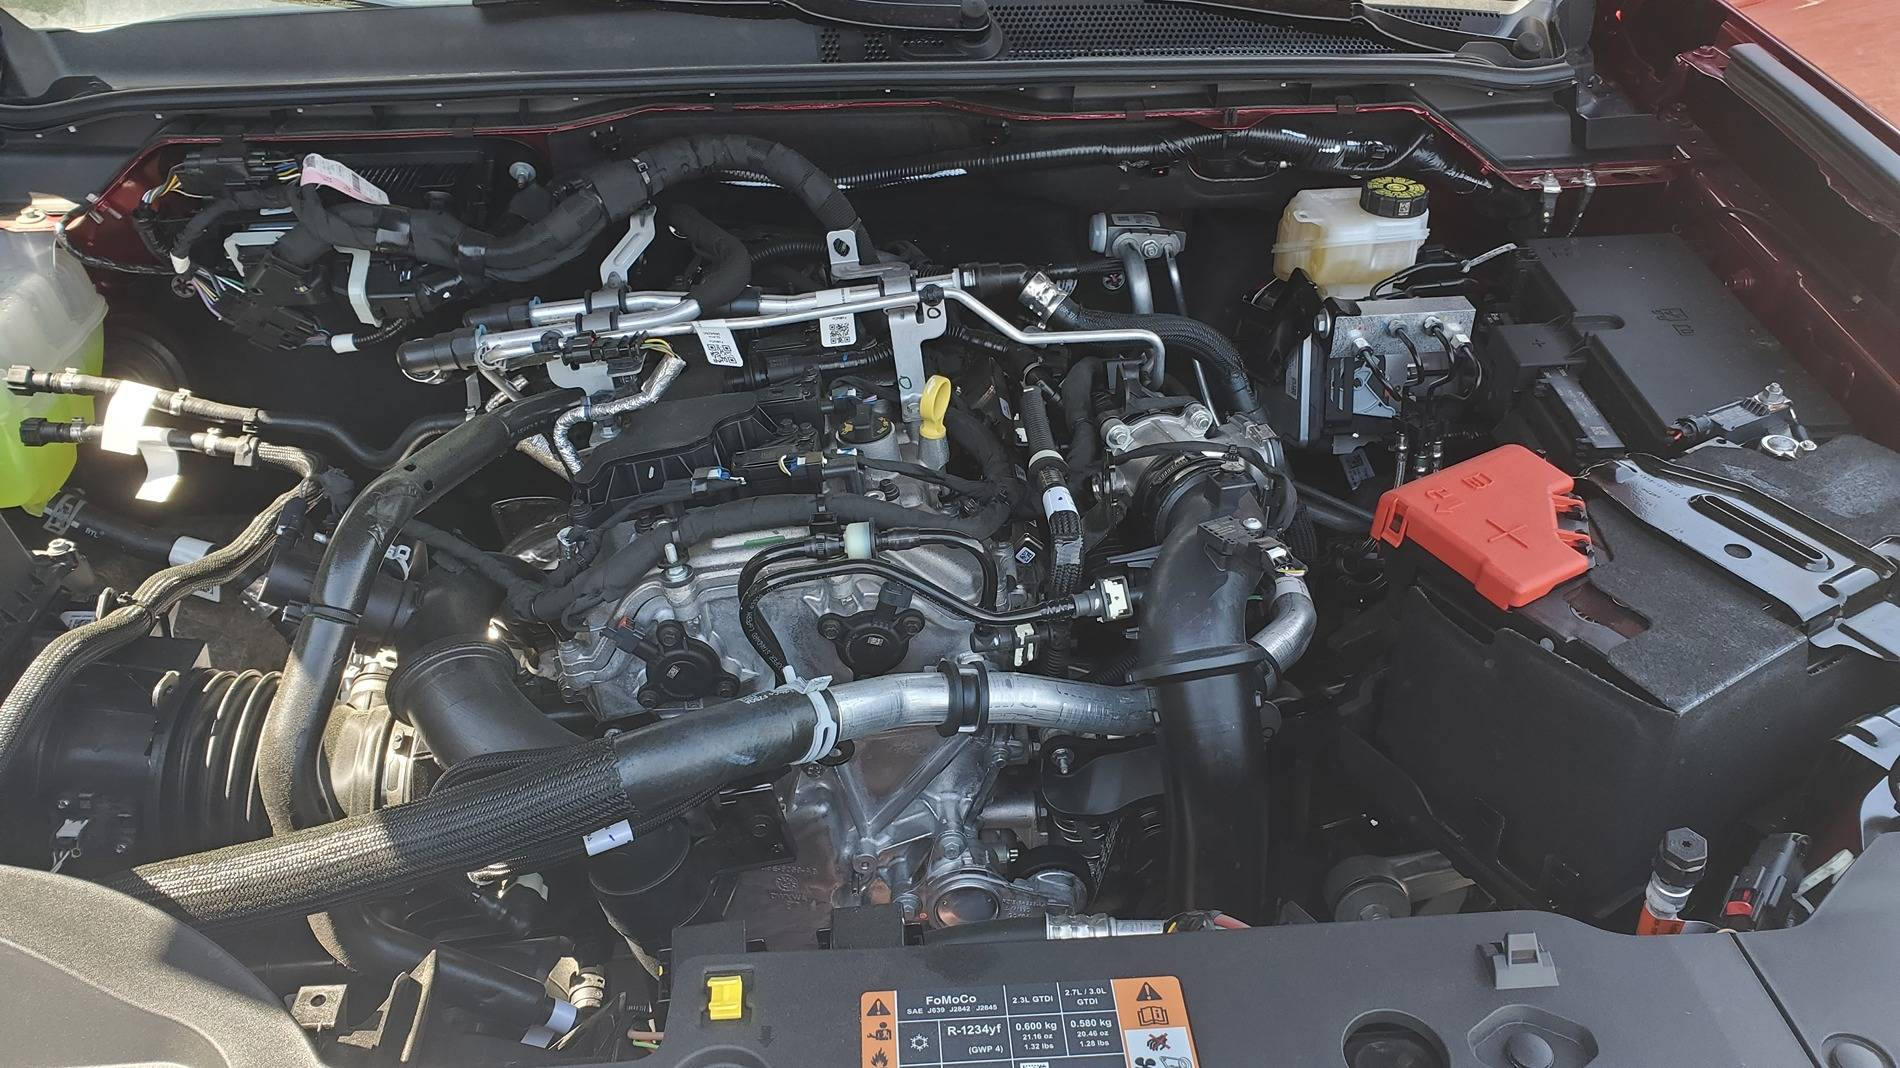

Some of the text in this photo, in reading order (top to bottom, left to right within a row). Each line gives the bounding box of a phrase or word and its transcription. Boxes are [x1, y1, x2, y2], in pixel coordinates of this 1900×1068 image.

[1088, 987, 1107, 995] 3.0L
[925, 994, 977, 1006] FoMoCo
[1012, 995, 1054, 1004] 2.3L GTDI
[1076, 997, 1099, 1006] GTDI
[906, 1007, 924, 1015] SAE
[1015, 1021, 1057, 1031] 0.600 kg
[1070, 1018, 1112, 1028] 0.580 kg
[947, 1023, 1002, 1036] R-1234yf
[1022, 1033, 1042, 1041] 21.16
[1041, 1042, 1054, 1050] lbs
[1079, 1039, 1110, 1048] 1.28 lbs
[968, 1045, 1004, 1055] (GWP 4)
